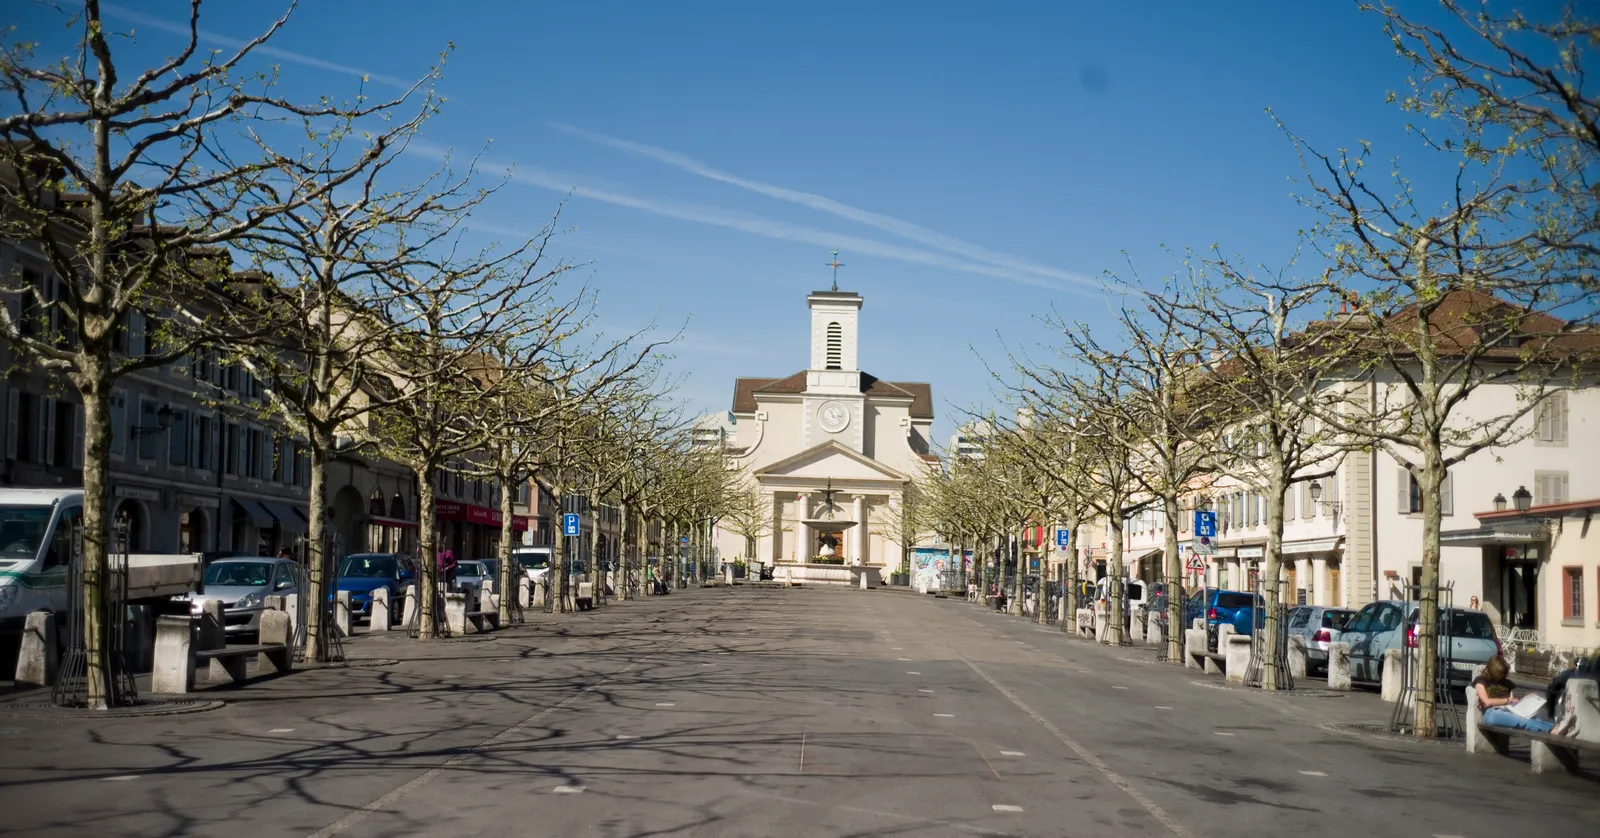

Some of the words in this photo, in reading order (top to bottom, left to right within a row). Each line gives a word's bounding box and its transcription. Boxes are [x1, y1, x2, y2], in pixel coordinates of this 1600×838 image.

[568, 516, 575, 526] P
[1201, 513, 1210, 526] P
[1061, 531, 1067, 539] P
